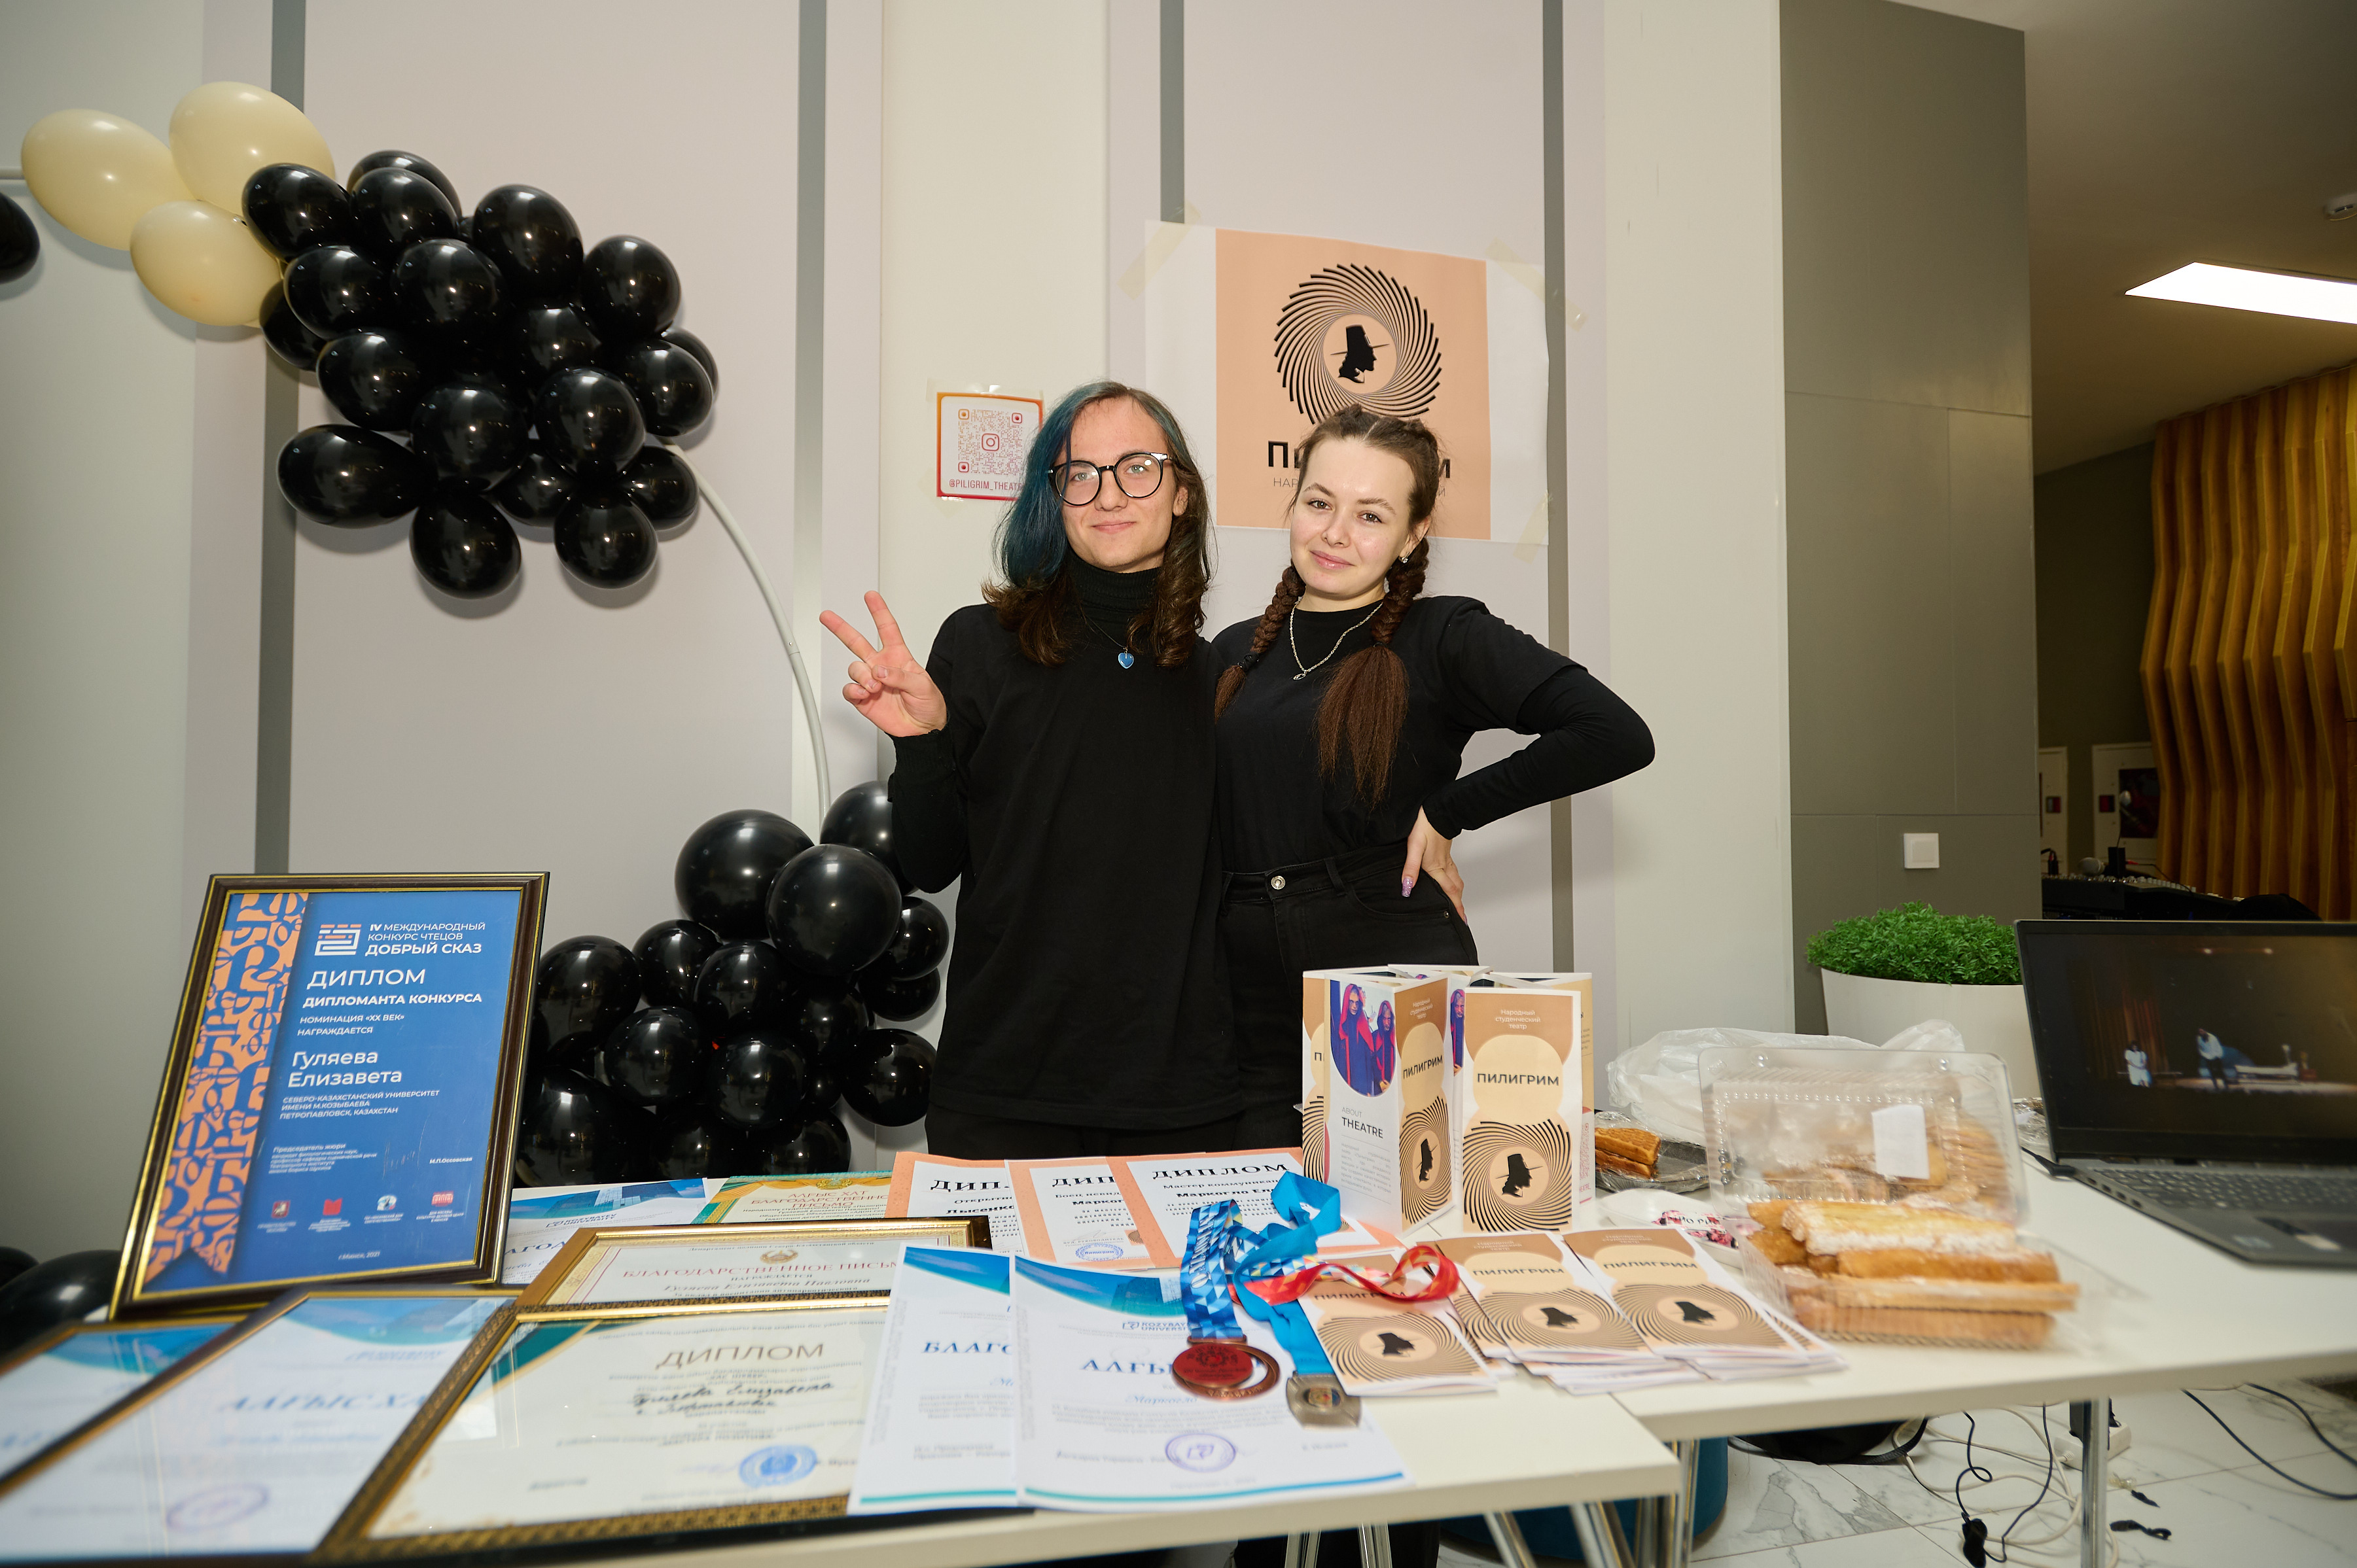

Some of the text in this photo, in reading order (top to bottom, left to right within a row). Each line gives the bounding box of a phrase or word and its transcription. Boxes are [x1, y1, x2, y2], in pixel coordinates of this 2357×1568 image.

[383, 922, 486, 932] МЕЖДУНАРОДНЫЙ
[364, 942, 482, 956] ДОБРЫЙ СКАЗ
[306, 969, 425, 990] ДИПЛОМ
[302, 994, 482, 1008] ДИПЛОМАНТА КОНКУРСА
[300, 1015, 363, 1024] НОМИНАЦИЯ
[297, 1026, 373, 1036] НАГРАЖДАЕТСЯ
[292, 1051, 378, 1070] Гуляева
[1403, 1054, 1443, 1079] ПИЛИГРИМ
[288, 1071, 402, 1088] Елизавета
[1478, 1073, 1559, 1086] ПИЛИГРИМ
[283, 1090, 440, 1104] СЕВЕРО-КАЗАХСТАНСКИЙ УНИВЕРСИТЕТ
[313, 1100, 370, 1109] М.КОЗЫБАЕВА
[279, 1107, 398, 1120] ПЕТРОПАВЛОВСК, КАЗАХСТАН
[1342, 1107, 1362, 1117] ABOUT
[1341, 1117, 1383, 1139] THEATRE
[1152, 1164, 1289, 1179] ДИПЛОМ
[930, 1180, 1010, 1192] ДИП
[563, 1217, 616, 1225] UNIVERSITY
[566, 1213, 617, 1223] KOZYBAYEV
[623, 1264, 833, 1278] БЛАГОДАРСТВЕННОЕ
[1473, 1268, 1565, 1277] ПИЛИГРИМ
[655, 1344, 824, 1370] ДИПЛОМ
